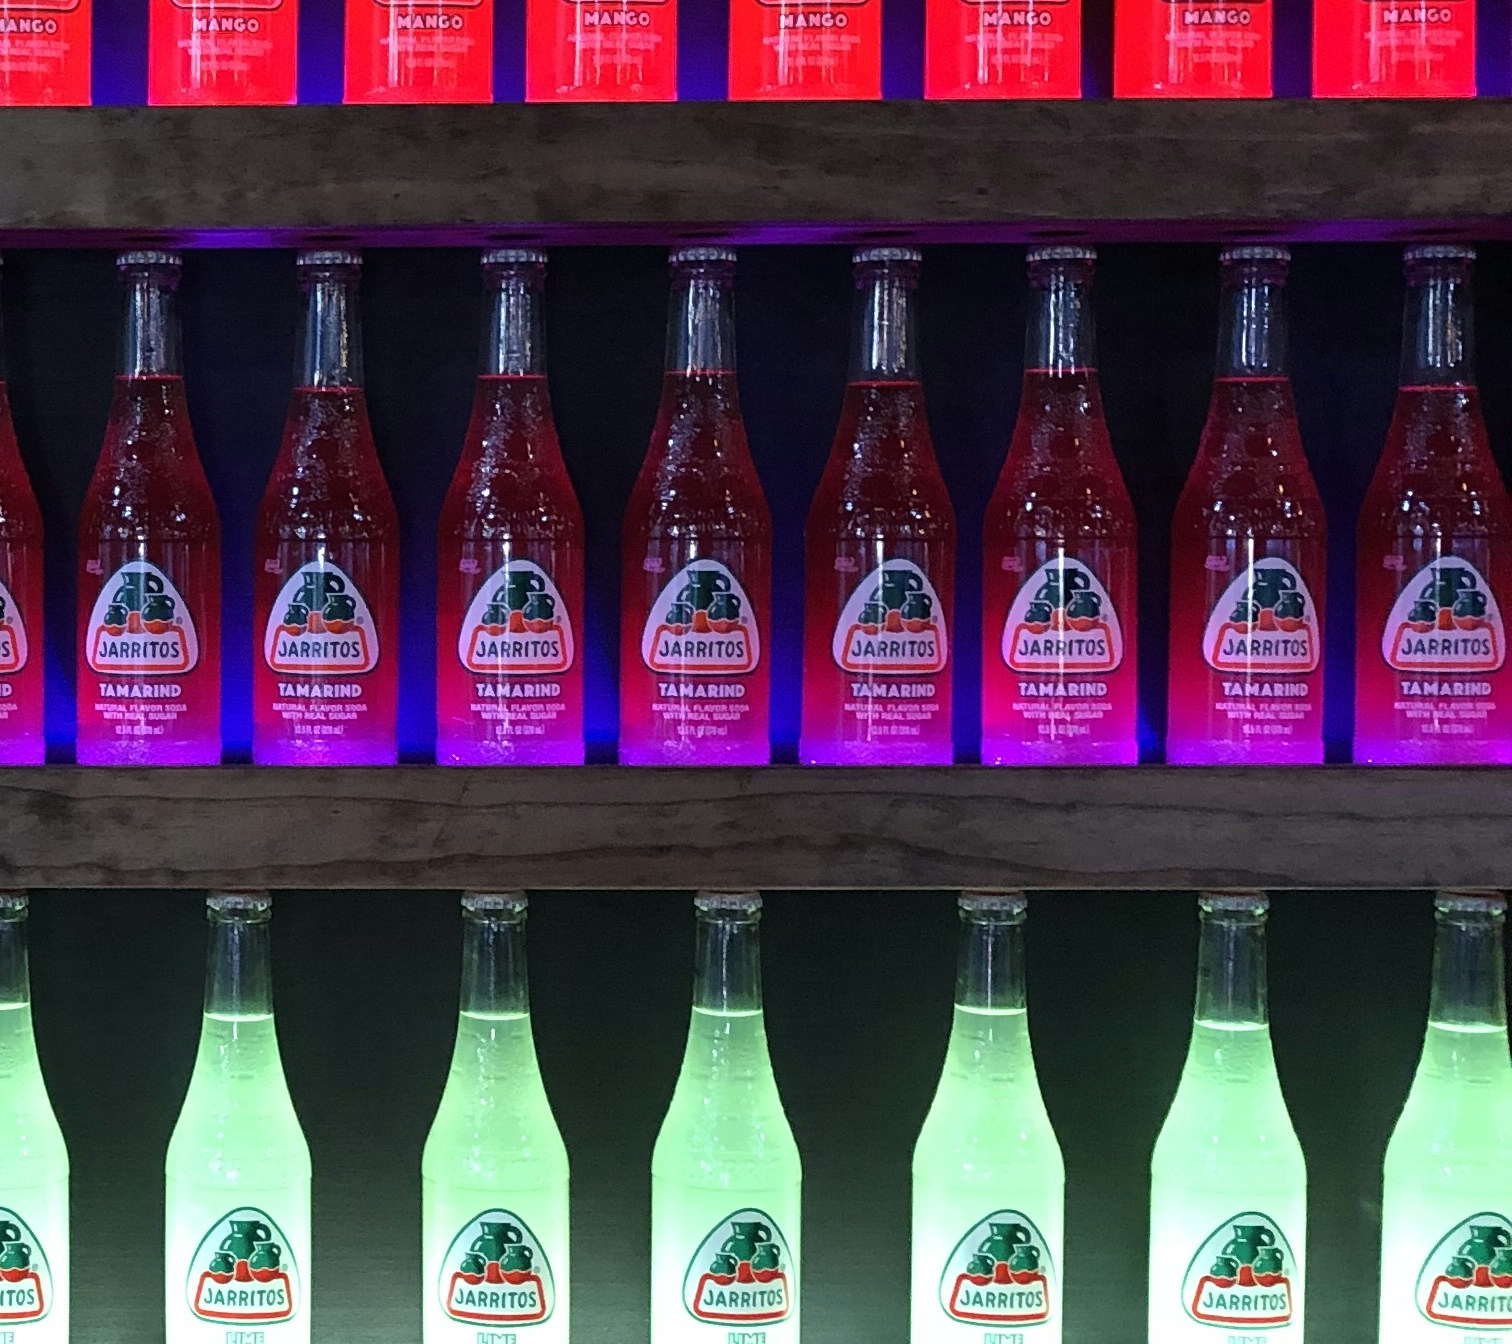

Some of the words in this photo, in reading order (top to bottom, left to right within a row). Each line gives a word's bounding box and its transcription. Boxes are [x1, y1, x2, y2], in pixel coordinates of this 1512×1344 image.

[396, 14, 464, 30] MANGO
[584, 11, 651, 28] MANGO
[780, 12, 848, 29] MANGO
[1183, 10, 1252, 26] MANGO
[1383, 7, 1452, 24] MANGO
[192, 18, 260, 34] MANGO
[98, 639, 180, 660] JARRITOS
[278, 640, 360, 660] JARRITOS
[475, 639, 560, 659] JARRITOS
[658, 639, 744, 660] JARRITOS
[850, 639, 935, 659] JARRITOS
[1018, 638, 1105, 658] JARRITOS
[1222, 638, 1308, 658] JARRITOS
[1400, 638, 1491, 658] JARRITOS
[98, 682, 182, 698] TAMARIND
[278, 682, 362, 698] TAMARIND
[476, 681, 561, 698] TAMARIND
[658, 682, 746, 698] TAMARIND
[850, 682, 936, 698] TAMARIND
[1018, 682, 1108, 697] TAMARIND
[1222, 681, 1309, 698] TAMARIND
[1400, 680, 1492, 698] TAMARIND
[204, 1288, 285, 1307] JARRITOS
[455, 1290, 537, 1309] JARRITOS
[703, 1288, 784, 1308] JARRITOS
[960, 1289, 1043, 1309] JARRITOS
[1202, 1292, 1287, 1312] JARRITOS
